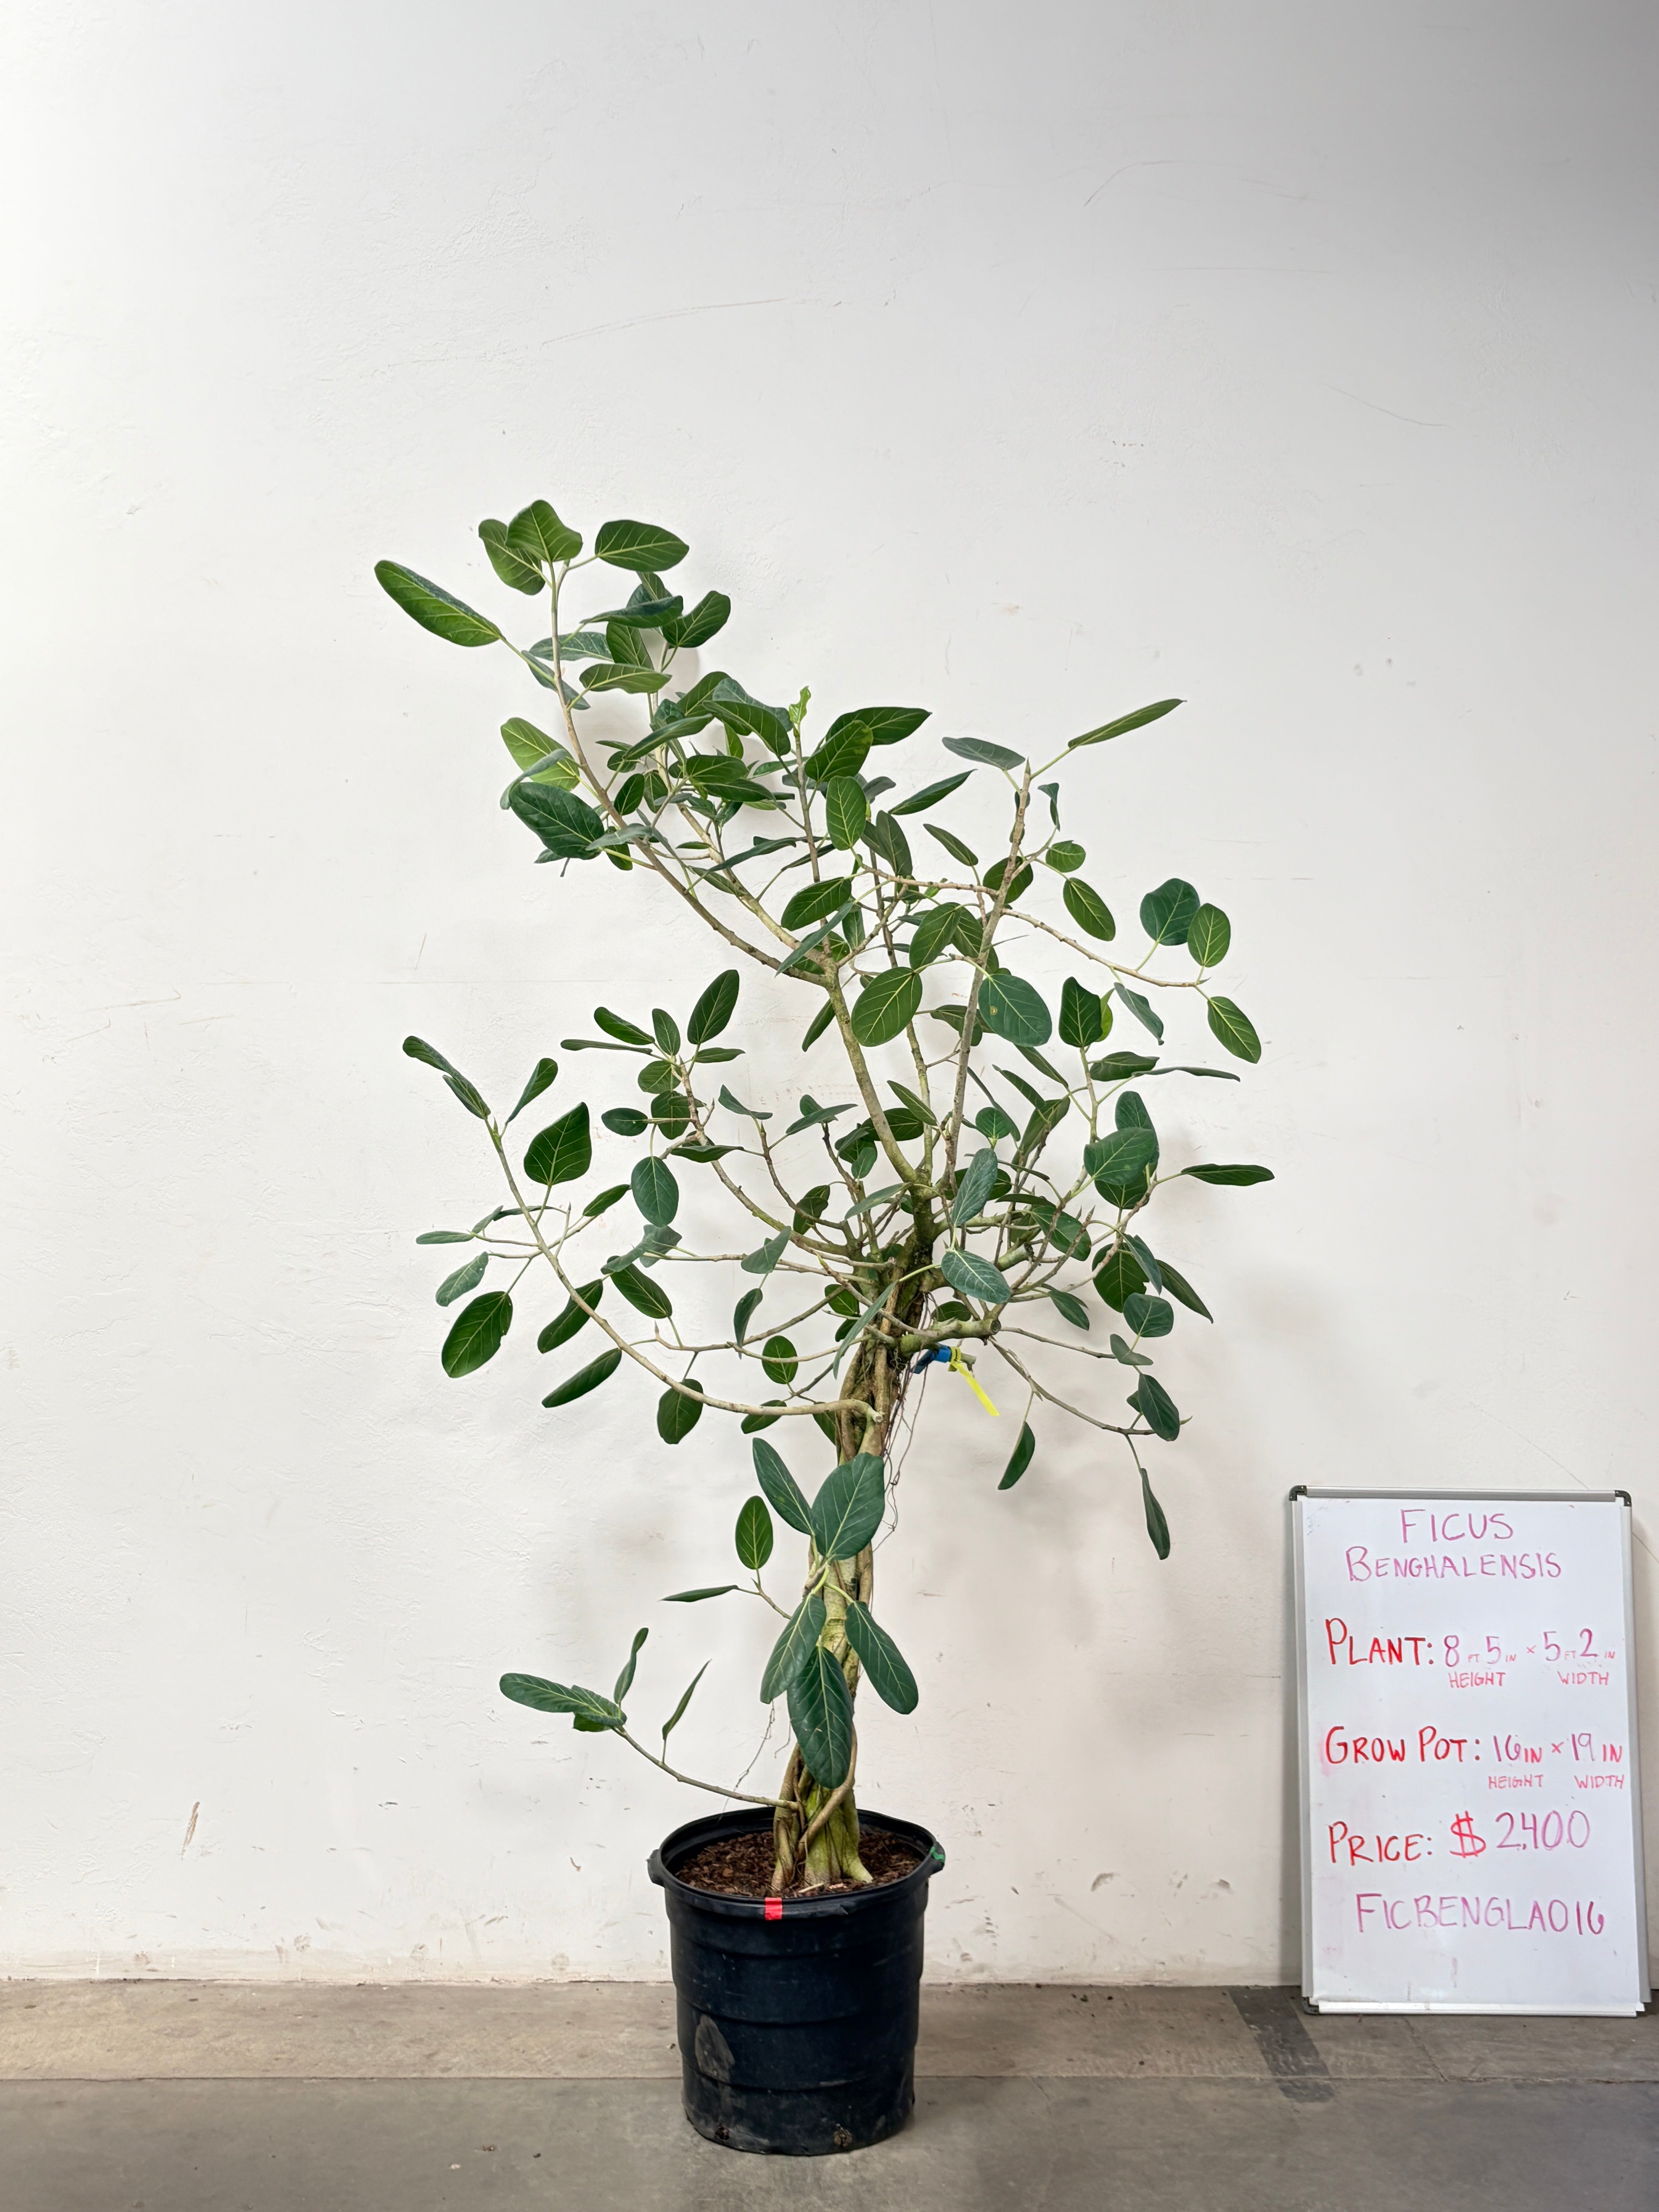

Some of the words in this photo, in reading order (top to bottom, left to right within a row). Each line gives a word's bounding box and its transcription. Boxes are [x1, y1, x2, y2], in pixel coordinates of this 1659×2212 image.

[1400, 1509, 1514, 1543] FICUS
[1345, 1546, 1562, 1582] BENGHALENSIS
[1324, 1617, 1434, 1667] PLANT:
[1443, 1635, 1460, 1668] 8
[1467, 1654, 1479, 1662] FT
[1485, 1636, 1501, 1665] 5
[1543, 1631, 1561, 1662] 5
[1579, 1628, 1599, 1658] 2
[1605, 1651, 1616, 1660] IN
[1448, 1671, 1506, 1689] HEIGHT
[1558, 1671, 1609, 1686] WIDTH
[1325, 1725, 1406, 1764] GROW
[1417, 1725, 1480, 1763] POT:
[1488, 1774, 1544, 1790] HEIGHT
[1574, 1775, 1625, 1790] WIDTH
[1328, 1820, 1433, 1867] PRICE:
